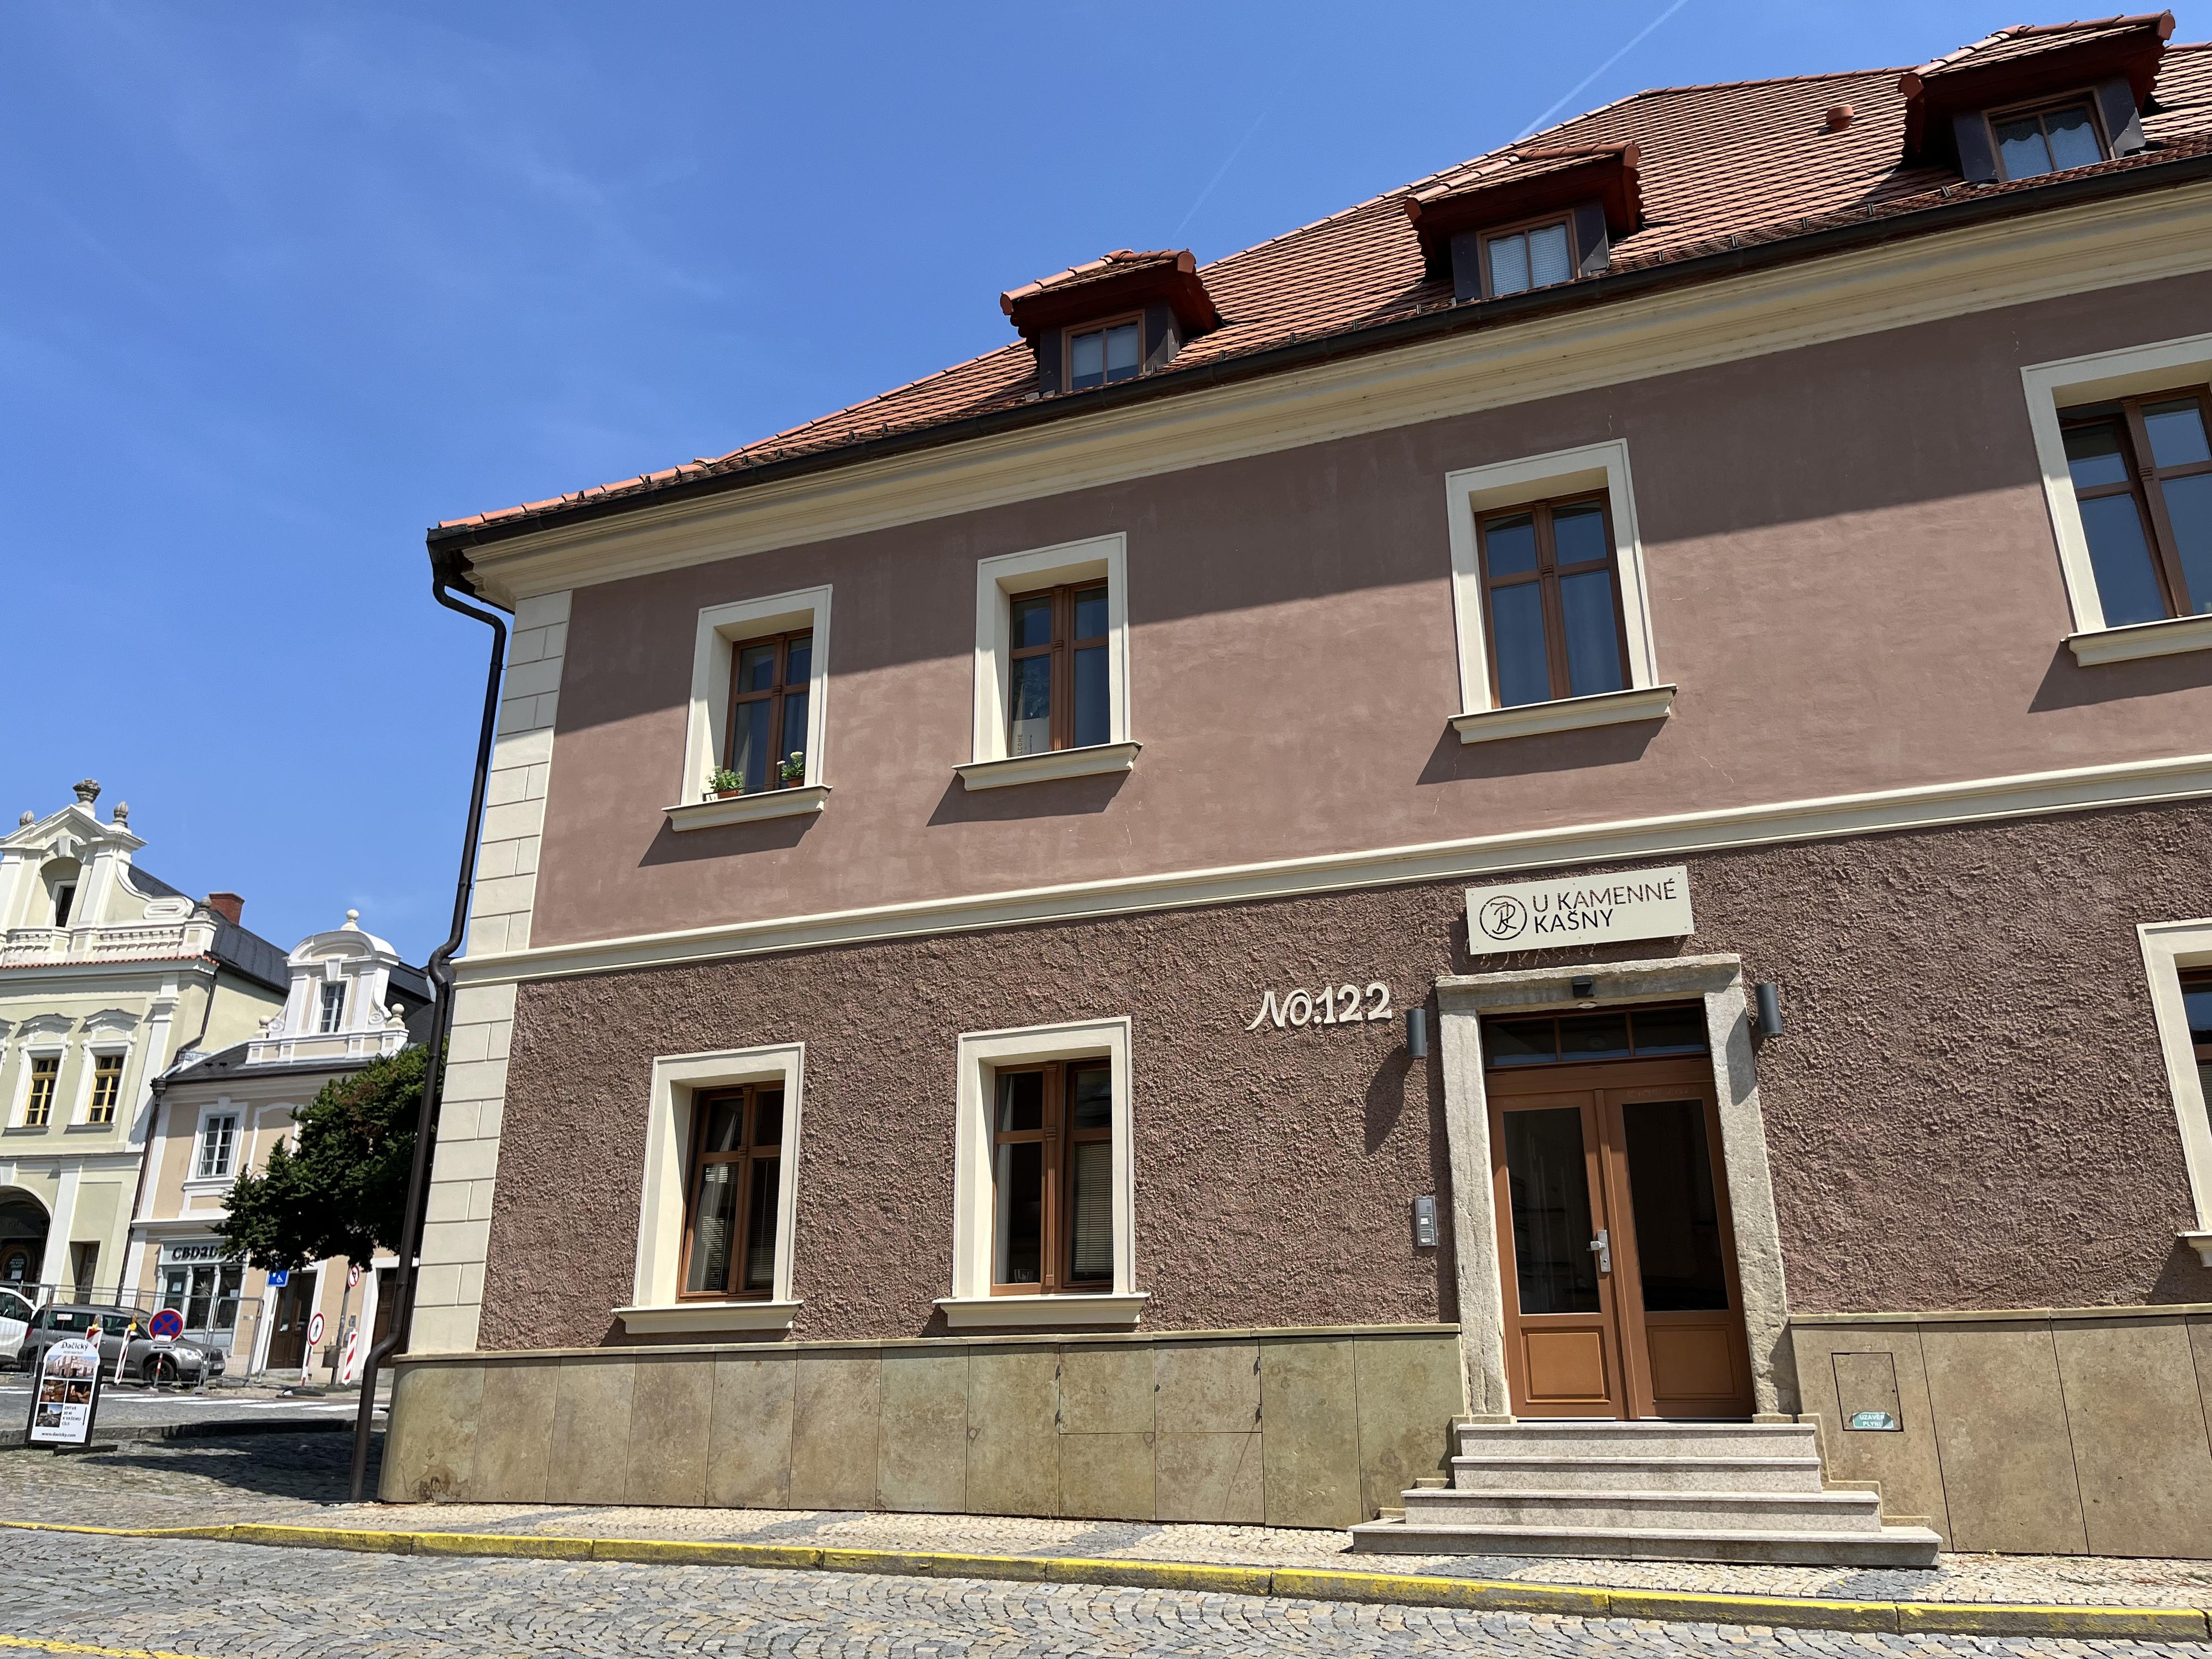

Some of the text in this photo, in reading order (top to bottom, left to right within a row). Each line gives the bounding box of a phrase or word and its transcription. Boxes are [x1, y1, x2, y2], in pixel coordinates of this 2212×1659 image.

[1533, 878, 1677, 913] U KAMENNÉ
[1534, 909, 1614, 934] KAŠNY
